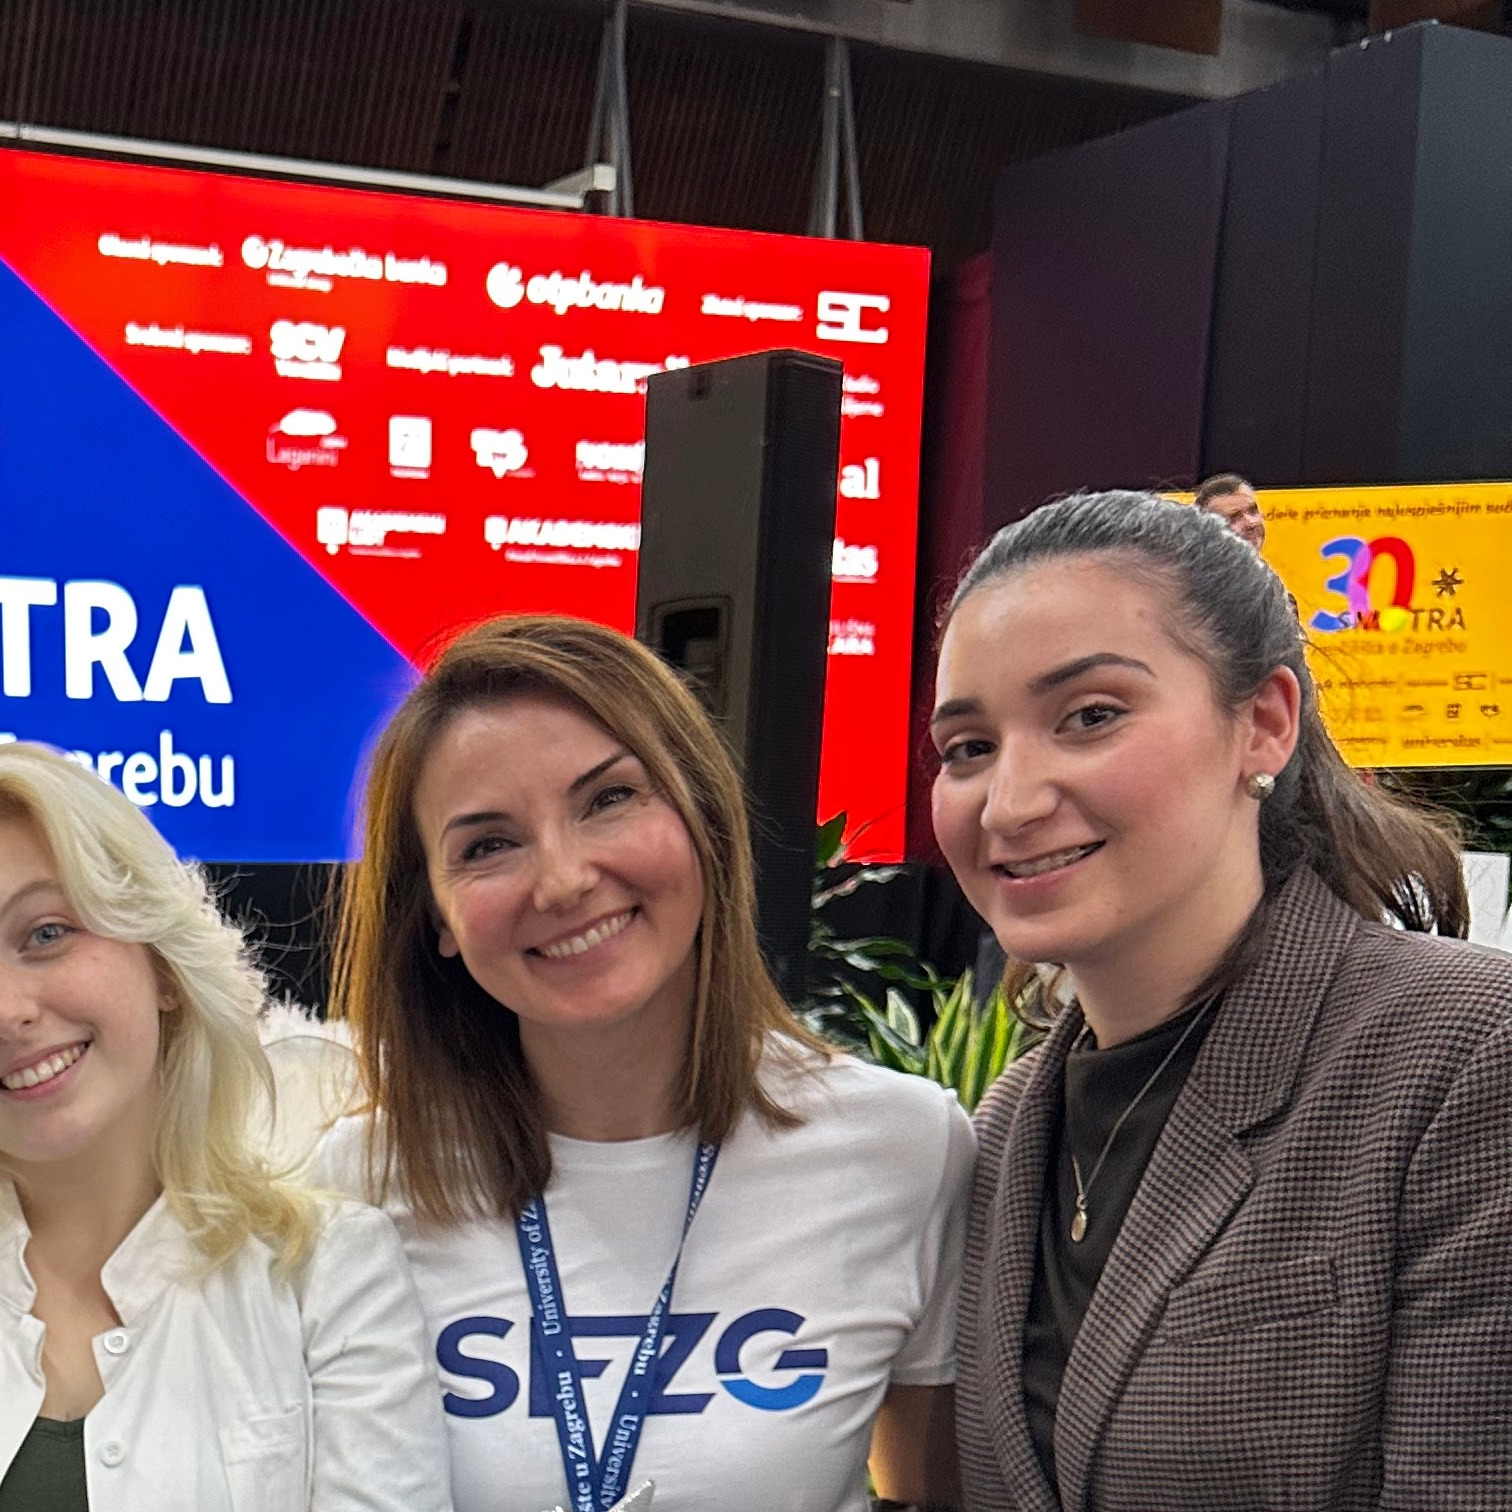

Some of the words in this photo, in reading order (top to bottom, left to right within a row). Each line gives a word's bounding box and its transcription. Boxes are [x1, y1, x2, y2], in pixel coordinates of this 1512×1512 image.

[1309, 537, 1415, 632] 30
[520, 1224, 542, 1242] of
[528, 1245, 561, 1336] University
[556, 1370, 587, 1460] Zagrebu
